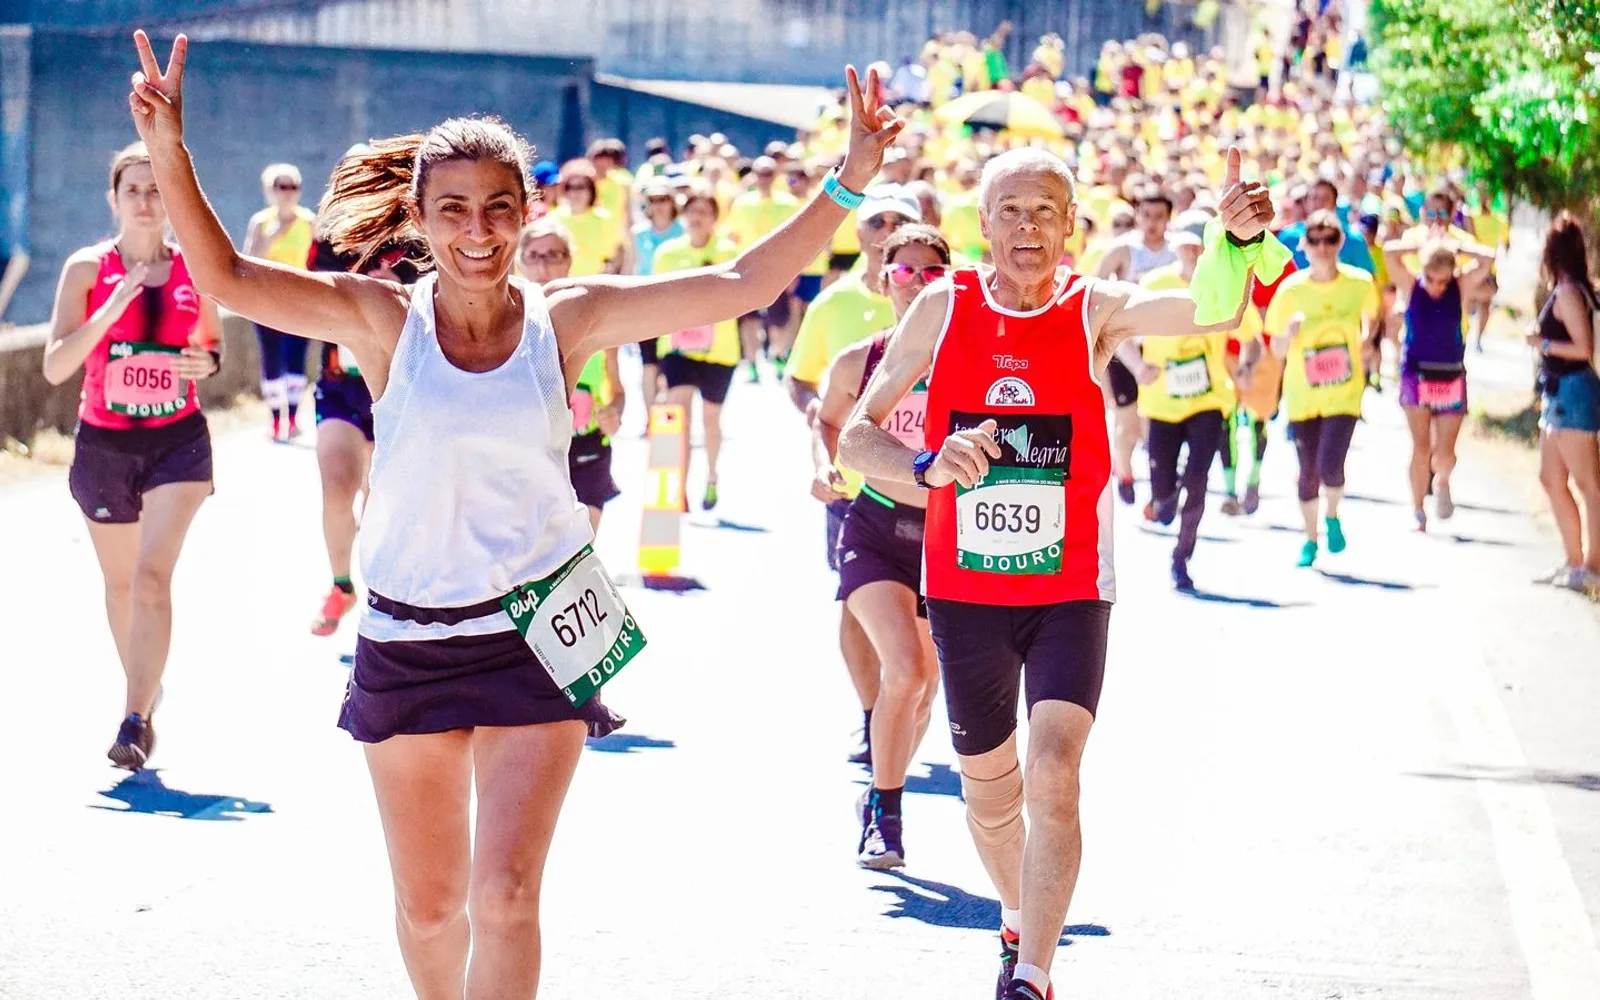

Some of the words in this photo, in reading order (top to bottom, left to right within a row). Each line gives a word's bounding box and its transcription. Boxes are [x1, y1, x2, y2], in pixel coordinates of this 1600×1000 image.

[123, 366, 172, 389] 6056
[126, 397, 187, 417] DOURO
[1015, 432, 1068, 469] alegria
[975, 501, 1041, 534] 6639
[983, 544, 1061, 571] DOURO
[551, 588, 608, 648] 6712
[587, 614, 636, 687] DOURO
